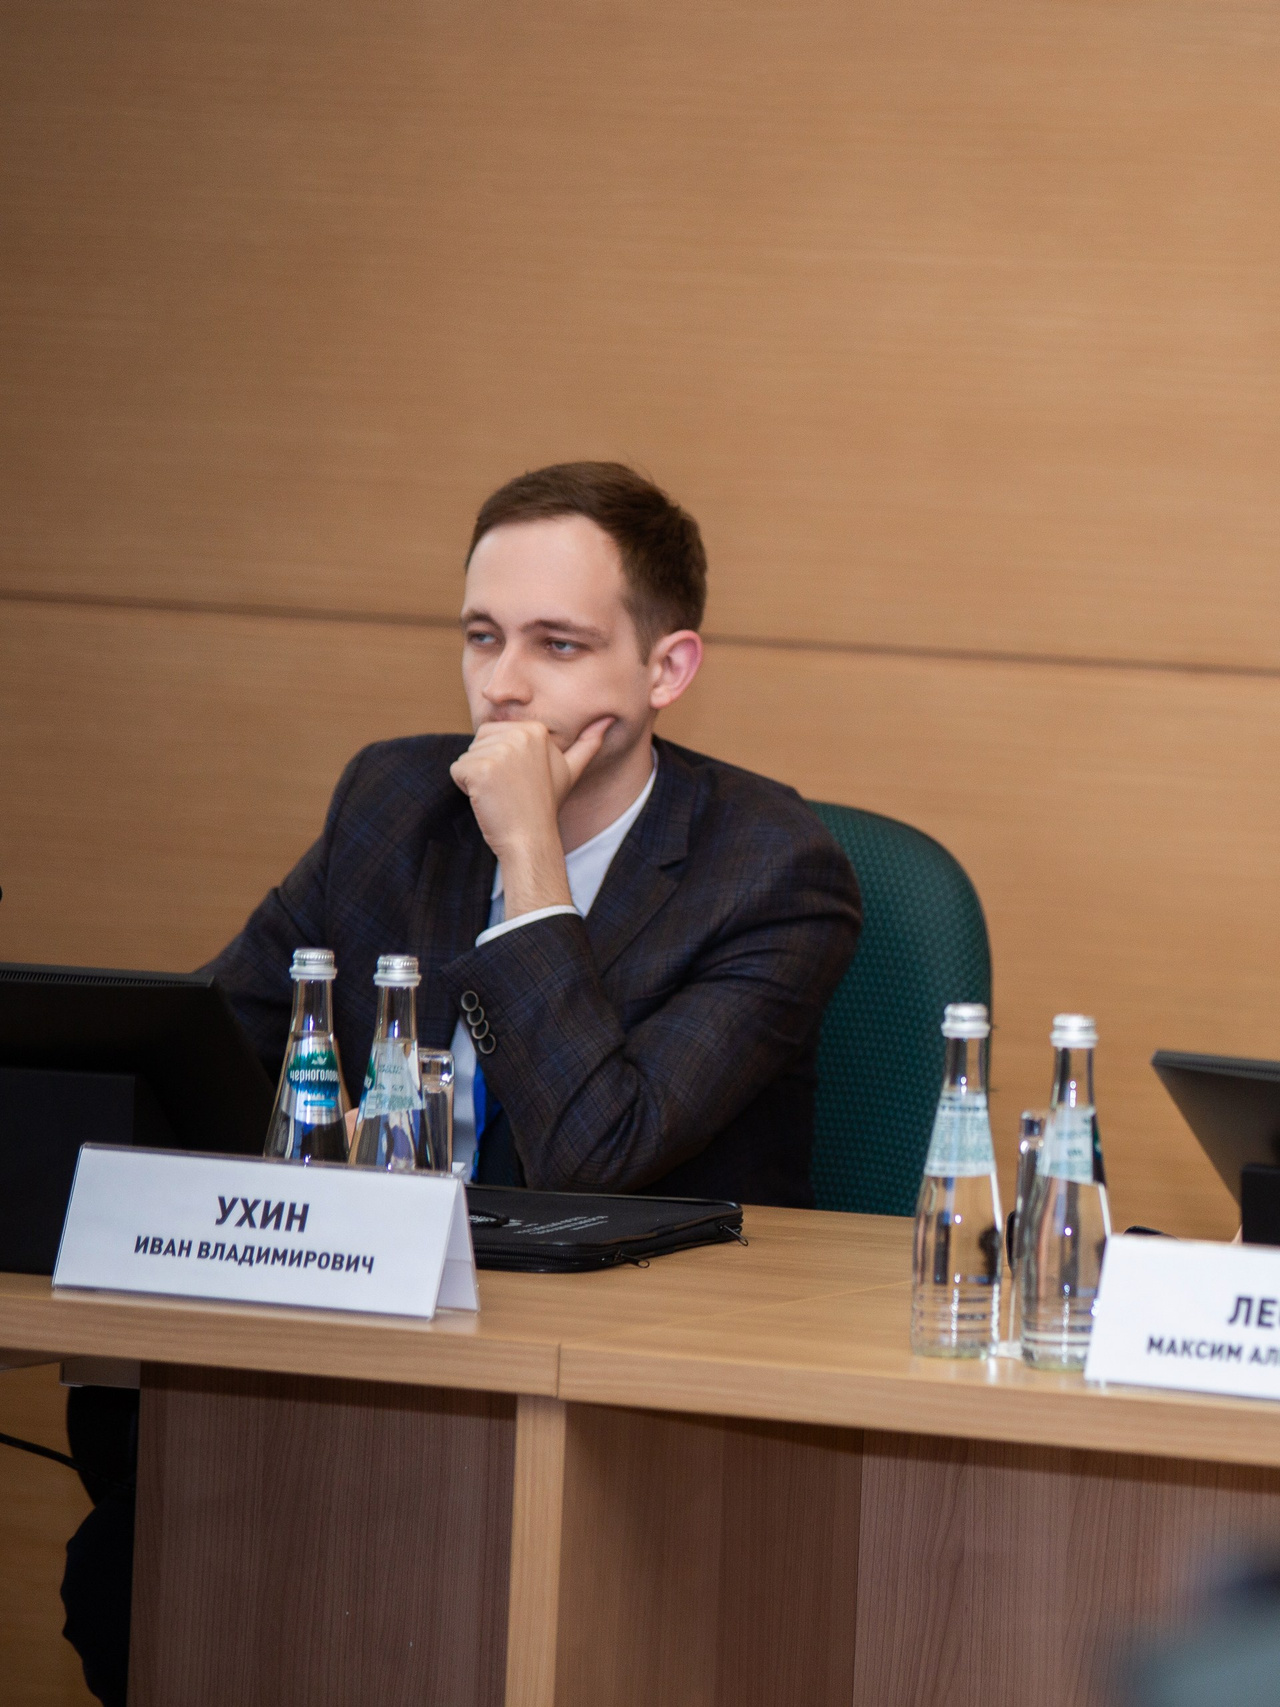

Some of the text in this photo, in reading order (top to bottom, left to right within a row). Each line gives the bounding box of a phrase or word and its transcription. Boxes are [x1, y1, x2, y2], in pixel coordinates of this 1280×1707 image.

[215, 1195, 310, 1233] УХИН
[134, 1235, 375, 1274] ИВАН ВЛАДИМИРОВИЧ
[1146, 1335, 1243, 1364] МАКСИМ
